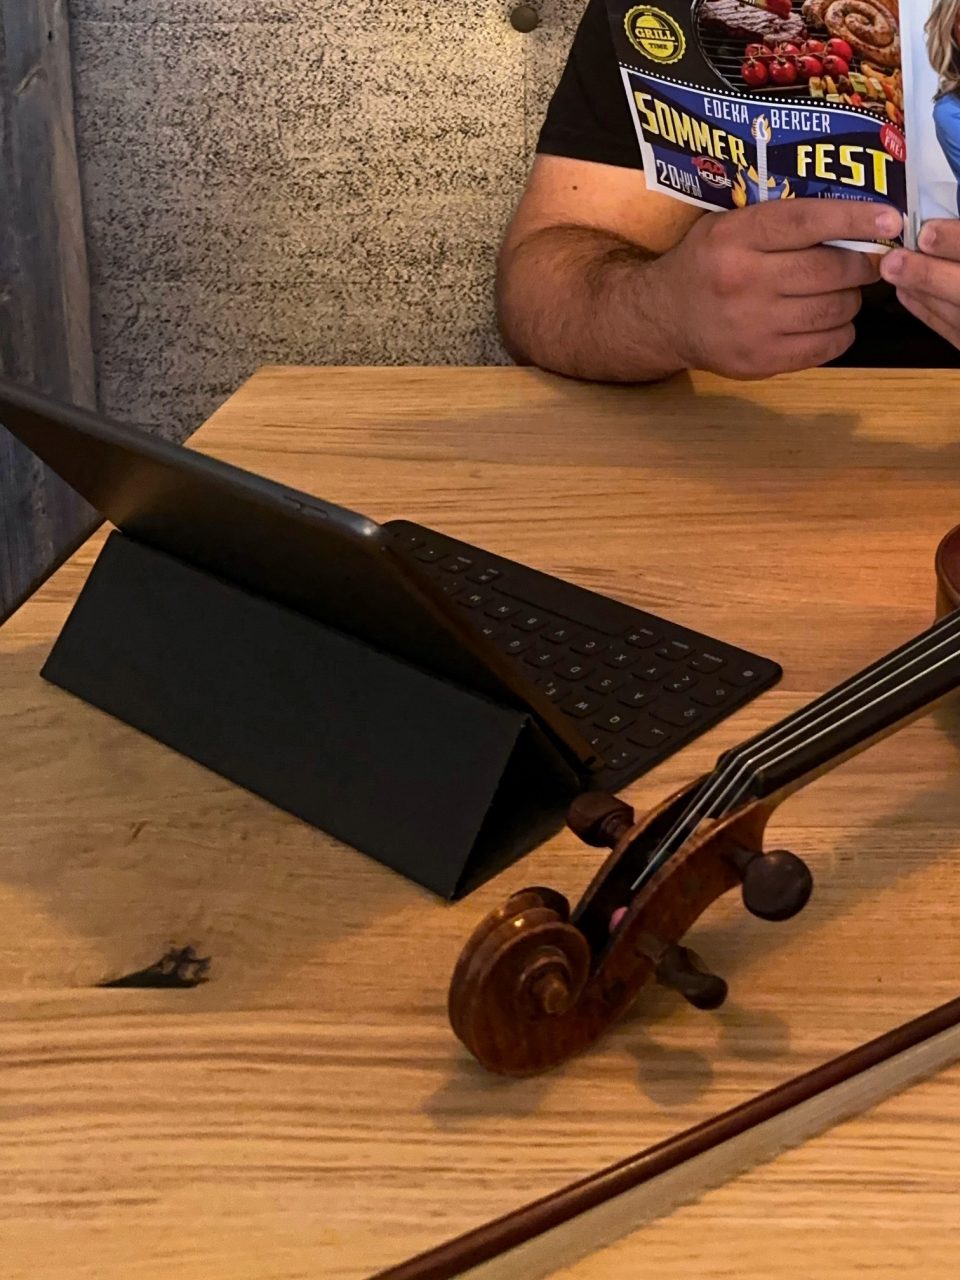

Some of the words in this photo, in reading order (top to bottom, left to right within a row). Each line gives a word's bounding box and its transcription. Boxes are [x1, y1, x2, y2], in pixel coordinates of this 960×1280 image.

[635, 28, 676, 41] GRILL
[648, 42, 669, 51] TIME
[633, 90, 749, 168] SOMMER
[703, 96, 750, 125] EDEKA
[770, 108, 832, 133] BERGER
[656, 159, 681, 189] 20
[697, 166, 733, 188] HOUSE
[797, 143, 894, 196] FEST
